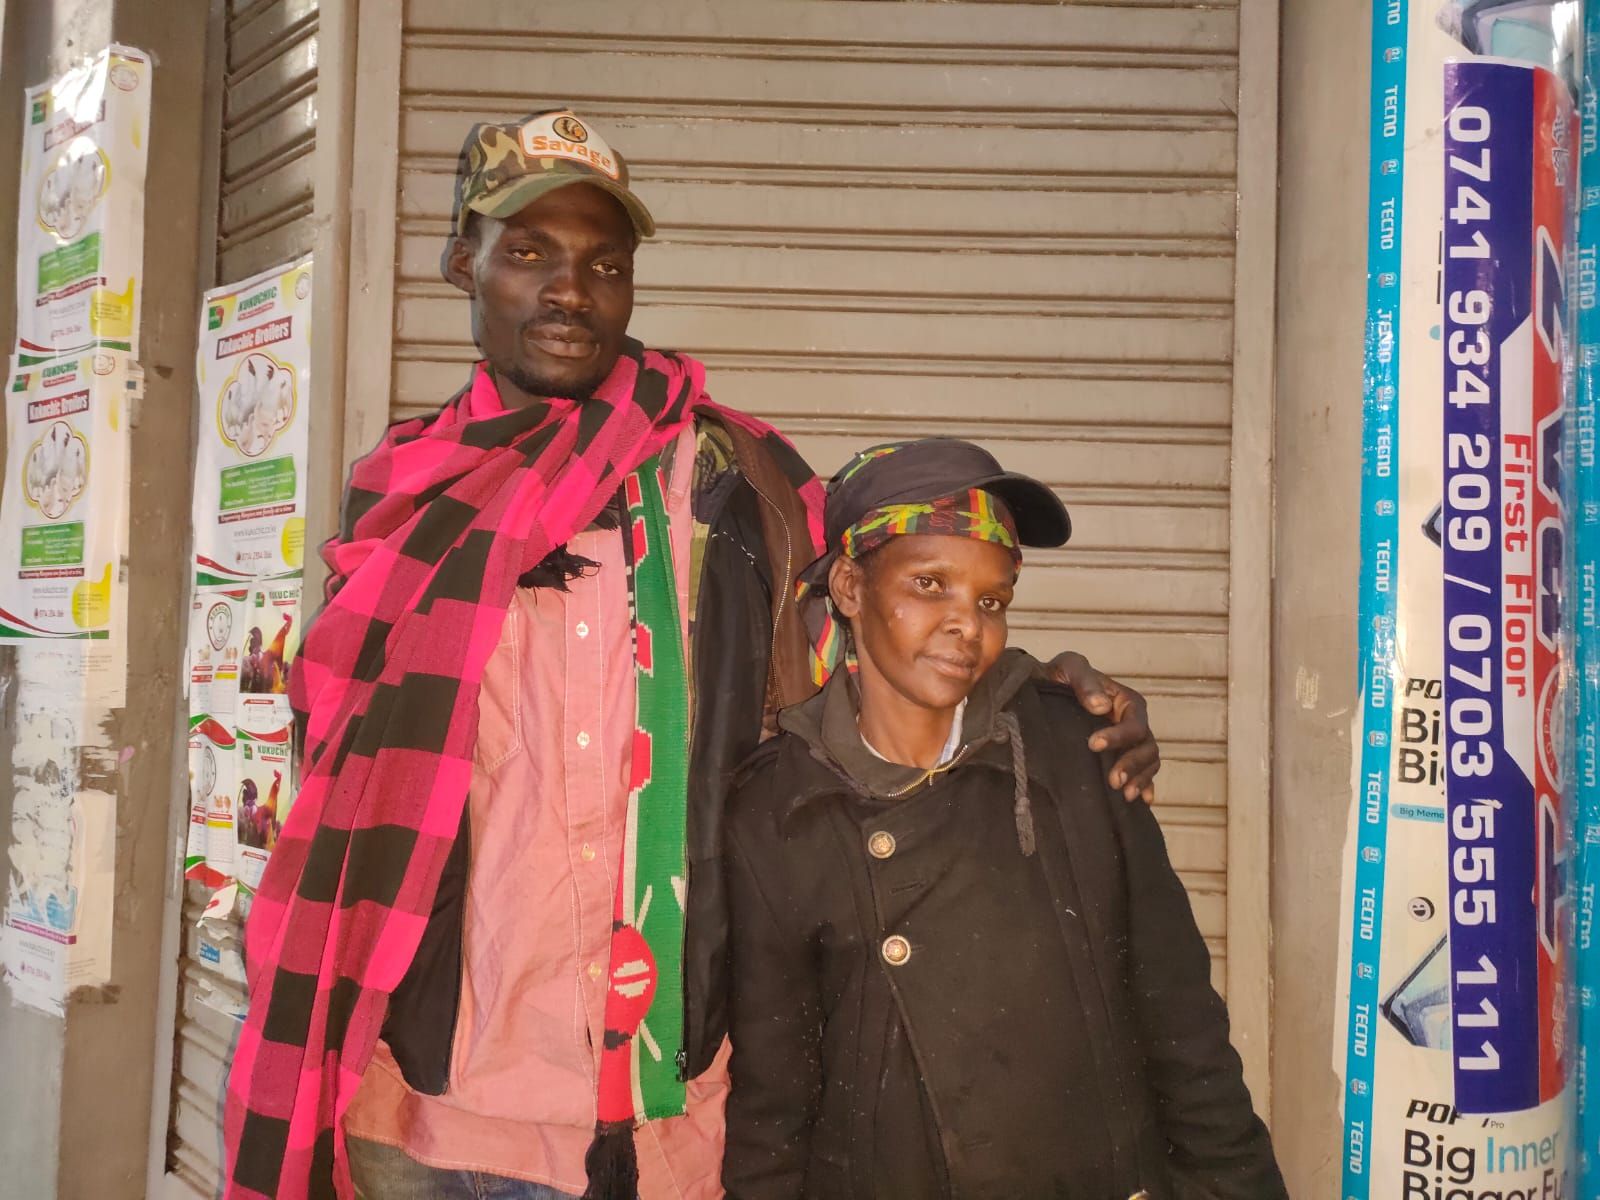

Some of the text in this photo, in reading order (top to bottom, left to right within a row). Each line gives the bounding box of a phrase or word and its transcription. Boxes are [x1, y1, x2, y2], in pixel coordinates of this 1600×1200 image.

[1384, 85, 1398, 138] TECNO
[532, 135, 611, 168] Savage
[1381, 197, 1395, 250] TECNO
[1578, 244, 1597, 309] TECNO
[1376, 424, 1391, 478] TECNO
[1578, 402, 1596, 467] TECNO
[1376, 538, 1391, 593] TECNO
[1444, 106, 1501, 1071] 0741 934 209 / 0703 555 111
[1504, 433, 1533, 698] First Floor
[1400, 707, 1444, 746] Bi
[1366, 770, 1382, 824] TECNO
[1397, 747, 1445, 797] Bi
[1400, 806, 1415, 819] Big
[1360, 887, 1376, 941] TECNO
[1354, 1003, 1370, 1057] TECNO
[1349, 1120, 1364, 1175] TECNO
[1490, 1120, 1505, 1129] Pro
[1403, 1128, 1559, 1185] Big Inner
[1402, 1170, 1538, 1200] Bir
